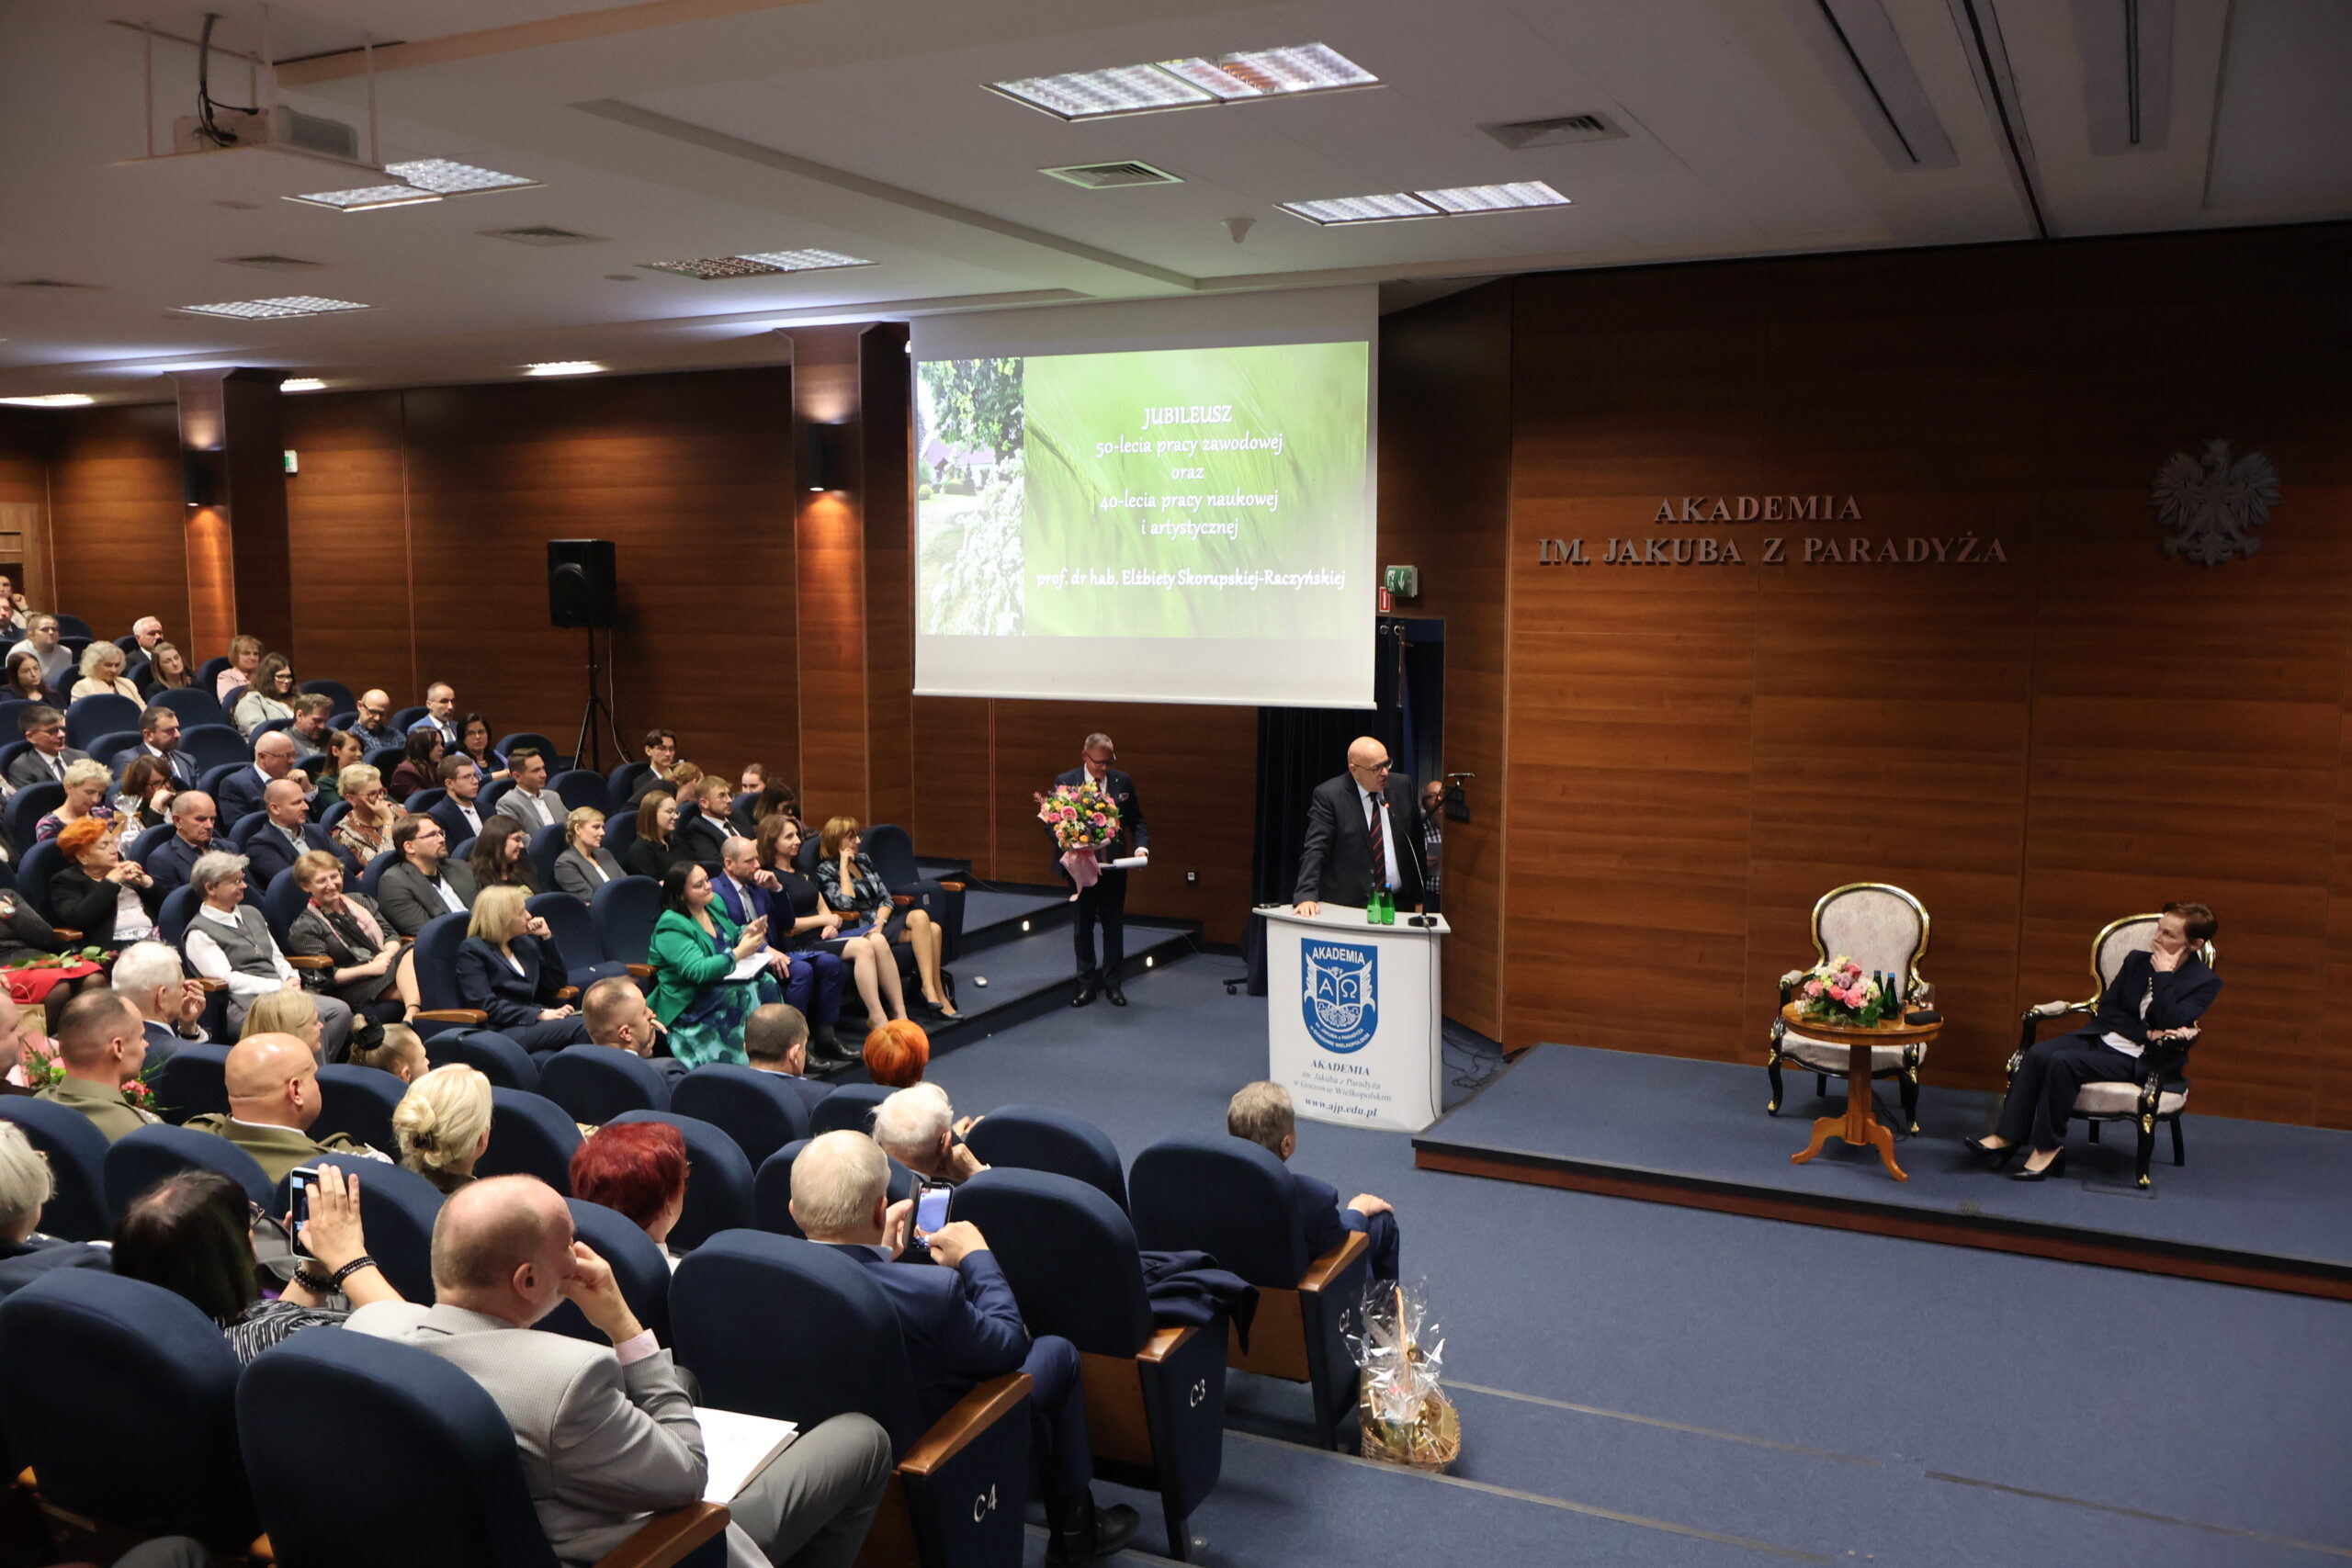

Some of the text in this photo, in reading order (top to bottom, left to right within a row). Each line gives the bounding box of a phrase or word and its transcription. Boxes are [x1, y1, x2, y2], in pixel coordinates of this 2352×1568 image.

[1141, 404, 1233, 430] JUBILEUSZ
[1095, 431, 1283, 457] 50-lecia pracy zawodowej
[1170, 467, 1204, 479] oraz
[1100, 487, 1279, 513] 40-lecia pracy naukowej
[1655, 495, 1862, 523] AKADEMIA
[1141, 518, 1239, 540] i artystycznej
[1539, 530, 2008, 563] IM. JAKUBA Z PARADYŻA
[1036, 568, 1346, 591] prof. dr hab. Elżbiety Skorupskiej-Raczyńskiej
[1312, 947, 1365, 965] AKADEMIA
[1340, 979, 1357, 998] Ω
[1310, 1059, 1370, 1076] AKADEMIA
[1314, 1073, 1338, 1084] Jakuba
[1305, 1098, 1377, 1118] www.ajp.edu.pl
[1339, 1308, 1350, 1333] C2
[1190, 1378, 1205, 1407] C3
[974, 1483, 997, 1522] C4
